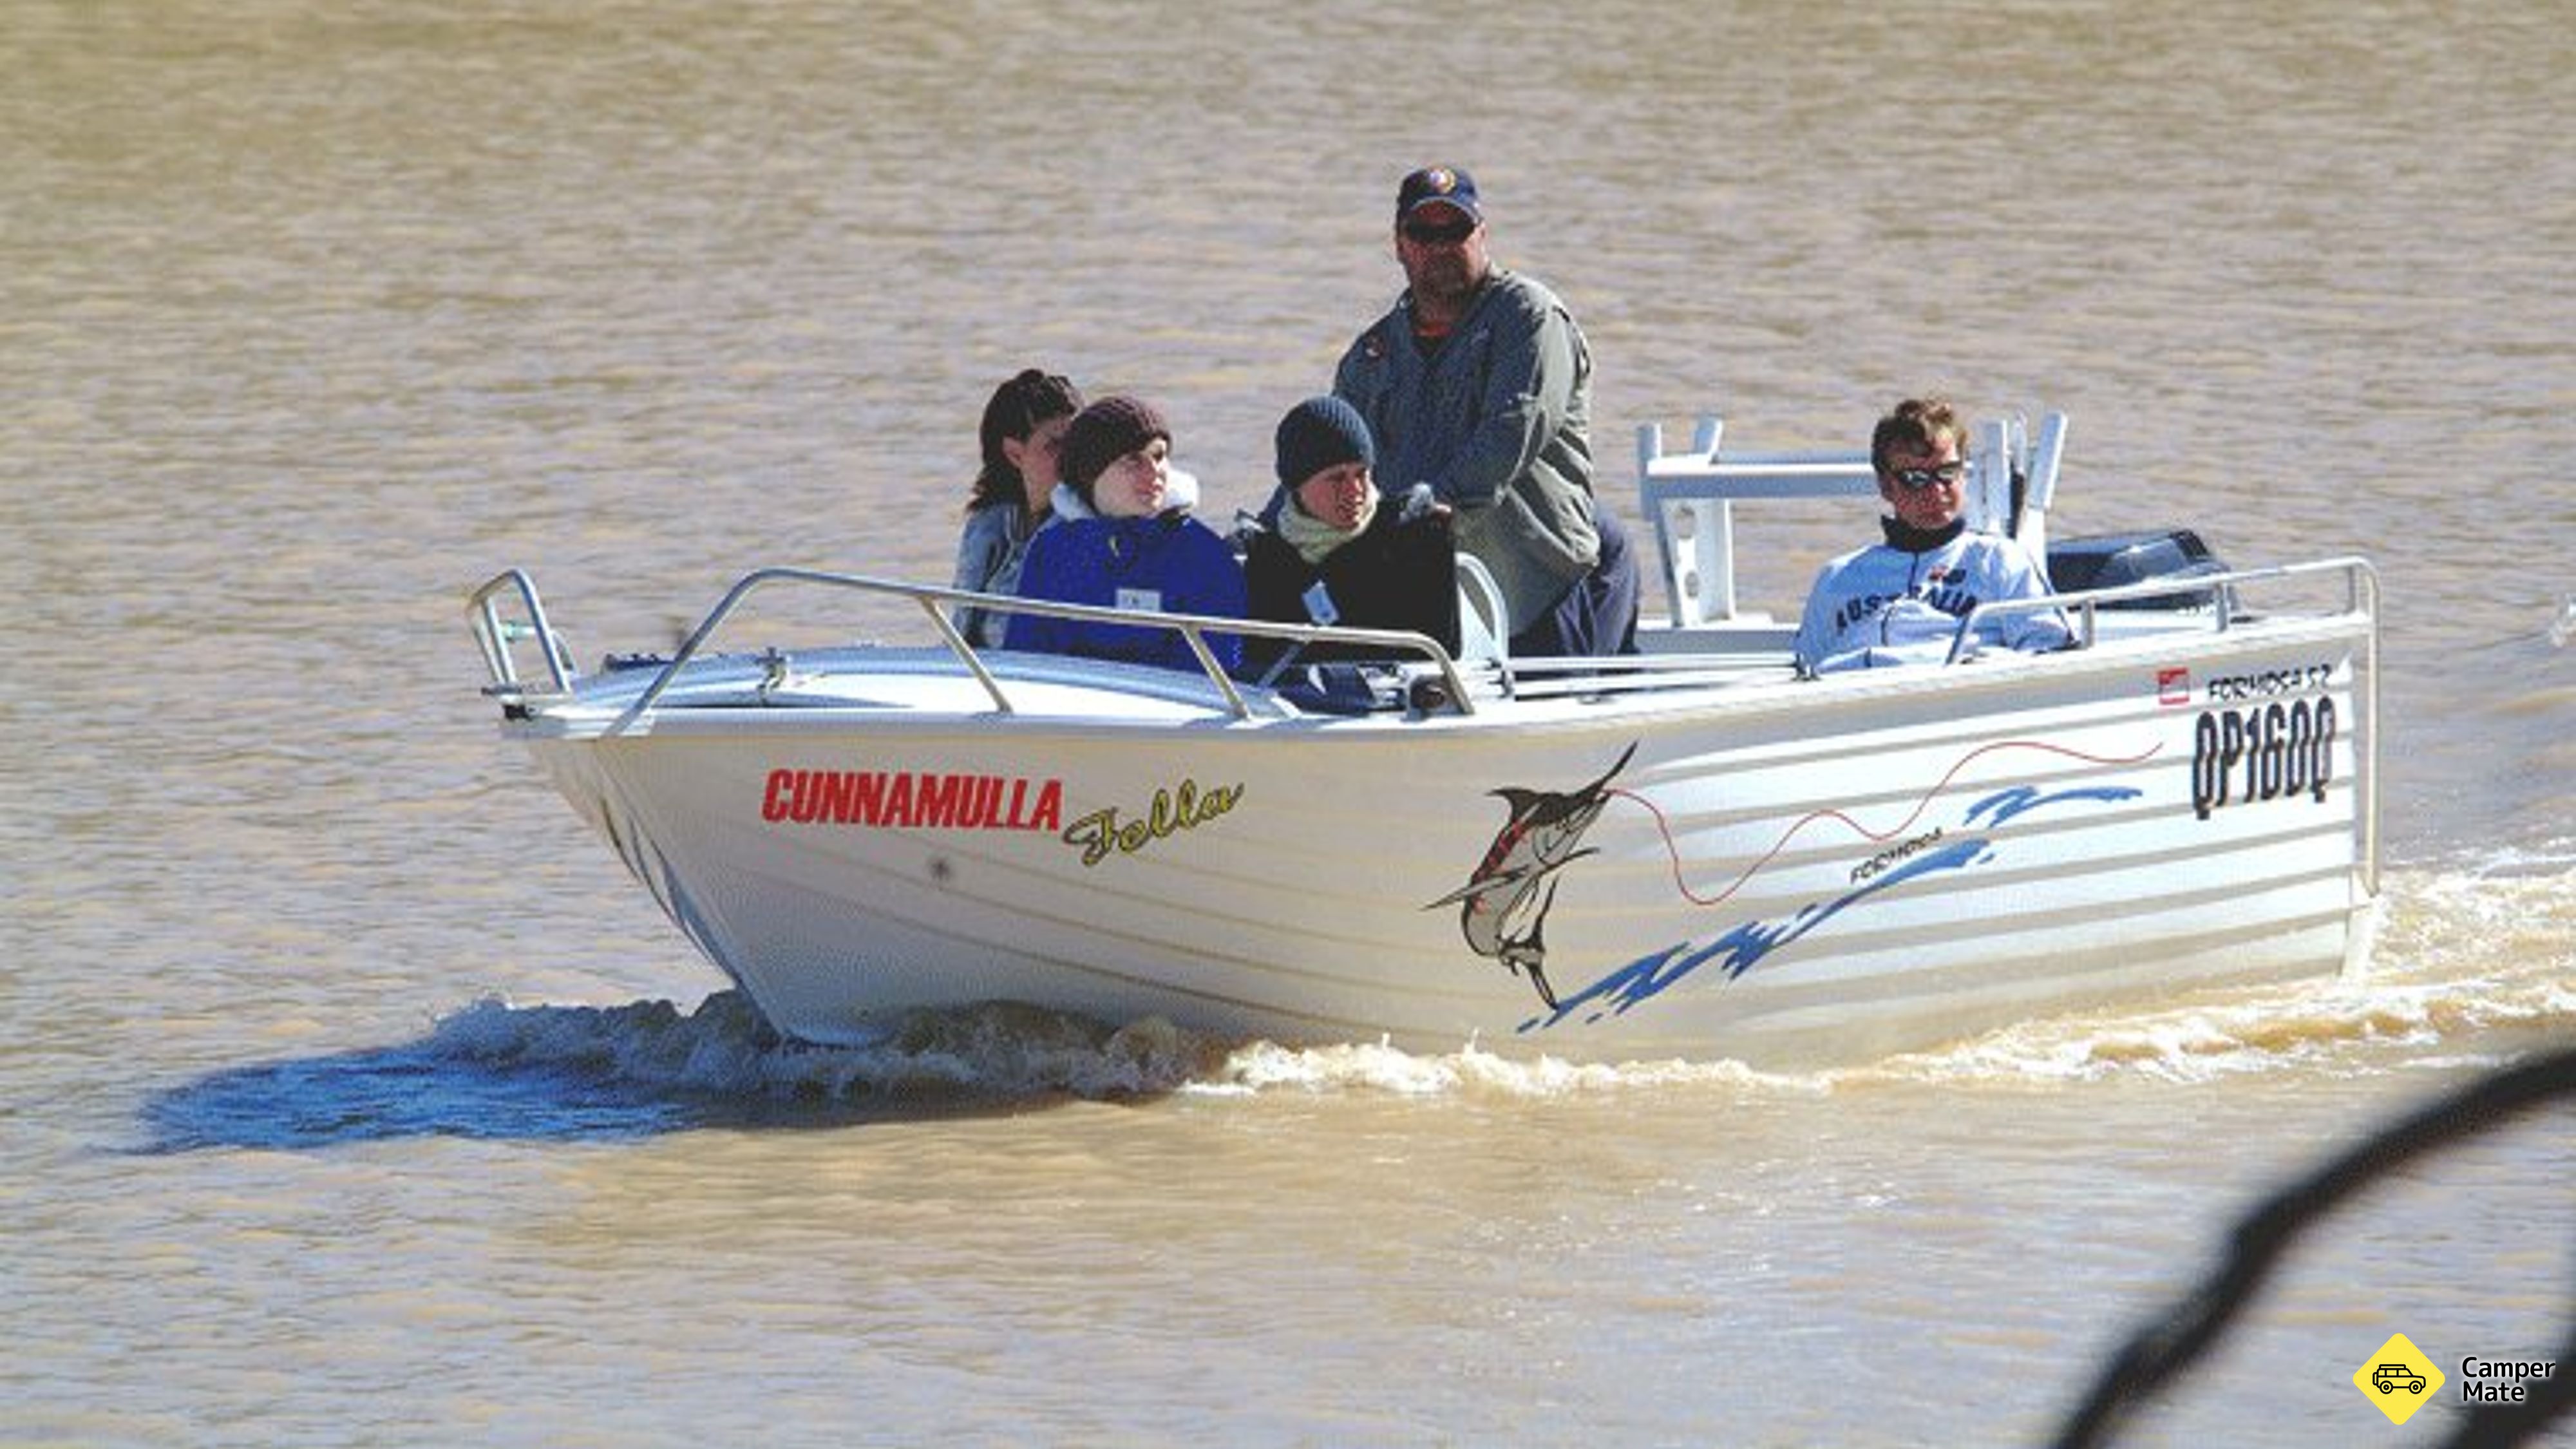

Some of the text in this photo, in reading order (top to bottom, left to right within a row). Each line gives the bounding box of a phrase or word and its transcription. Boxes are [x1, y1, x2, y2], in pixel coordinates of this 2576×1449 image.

[2192, 696, 2336, 820] QP160Q
[762, 769, 1244, 866] CUNNAMULLA Fella
